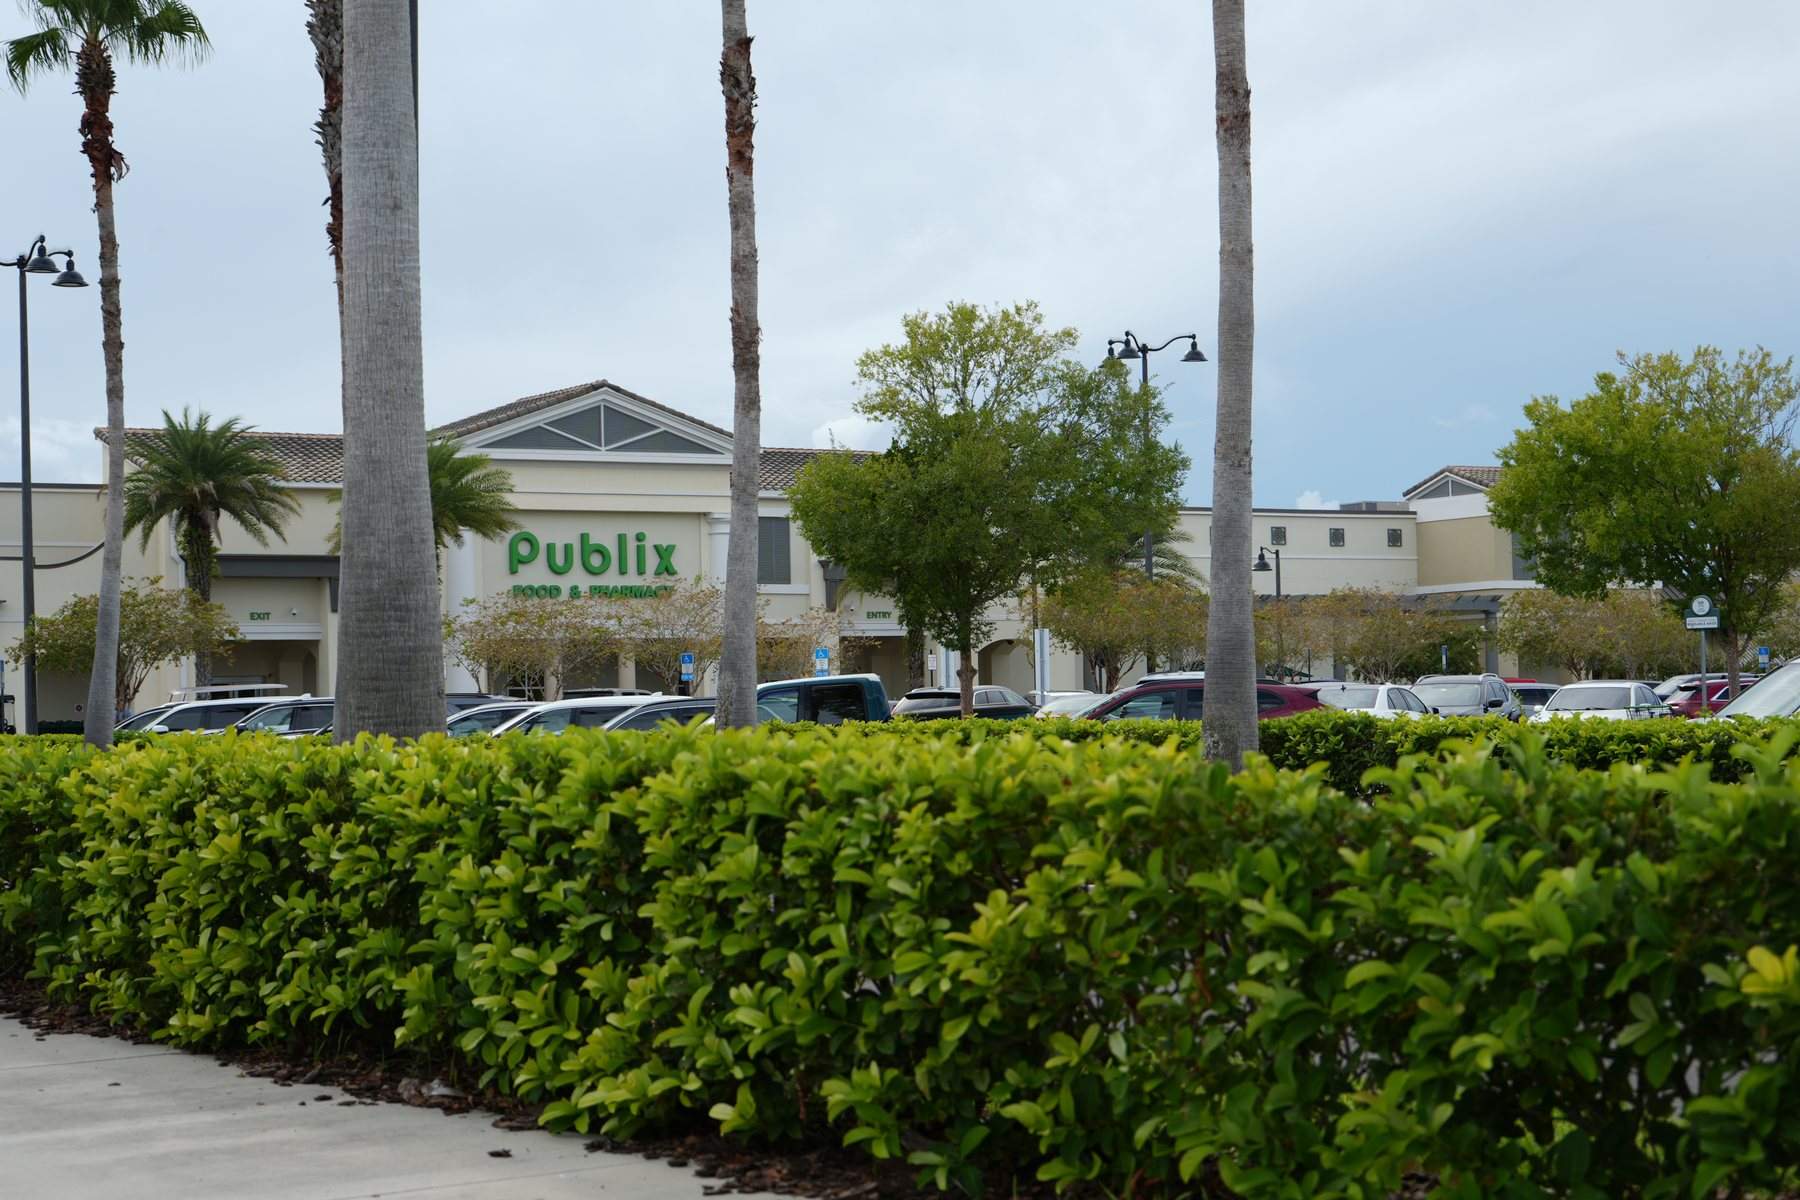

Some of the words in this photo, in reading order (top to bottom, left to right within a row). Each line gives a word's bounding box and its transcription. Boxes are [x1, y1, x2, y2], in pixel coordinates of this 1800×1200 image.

[508, 531, 678, 576] Publix
[512, 585, 562, 599] FOOD
[569, 584, 582, 599] &
[249, 612, 272, 620] EXIT
[866, 611, 892, 619] ENTRY
